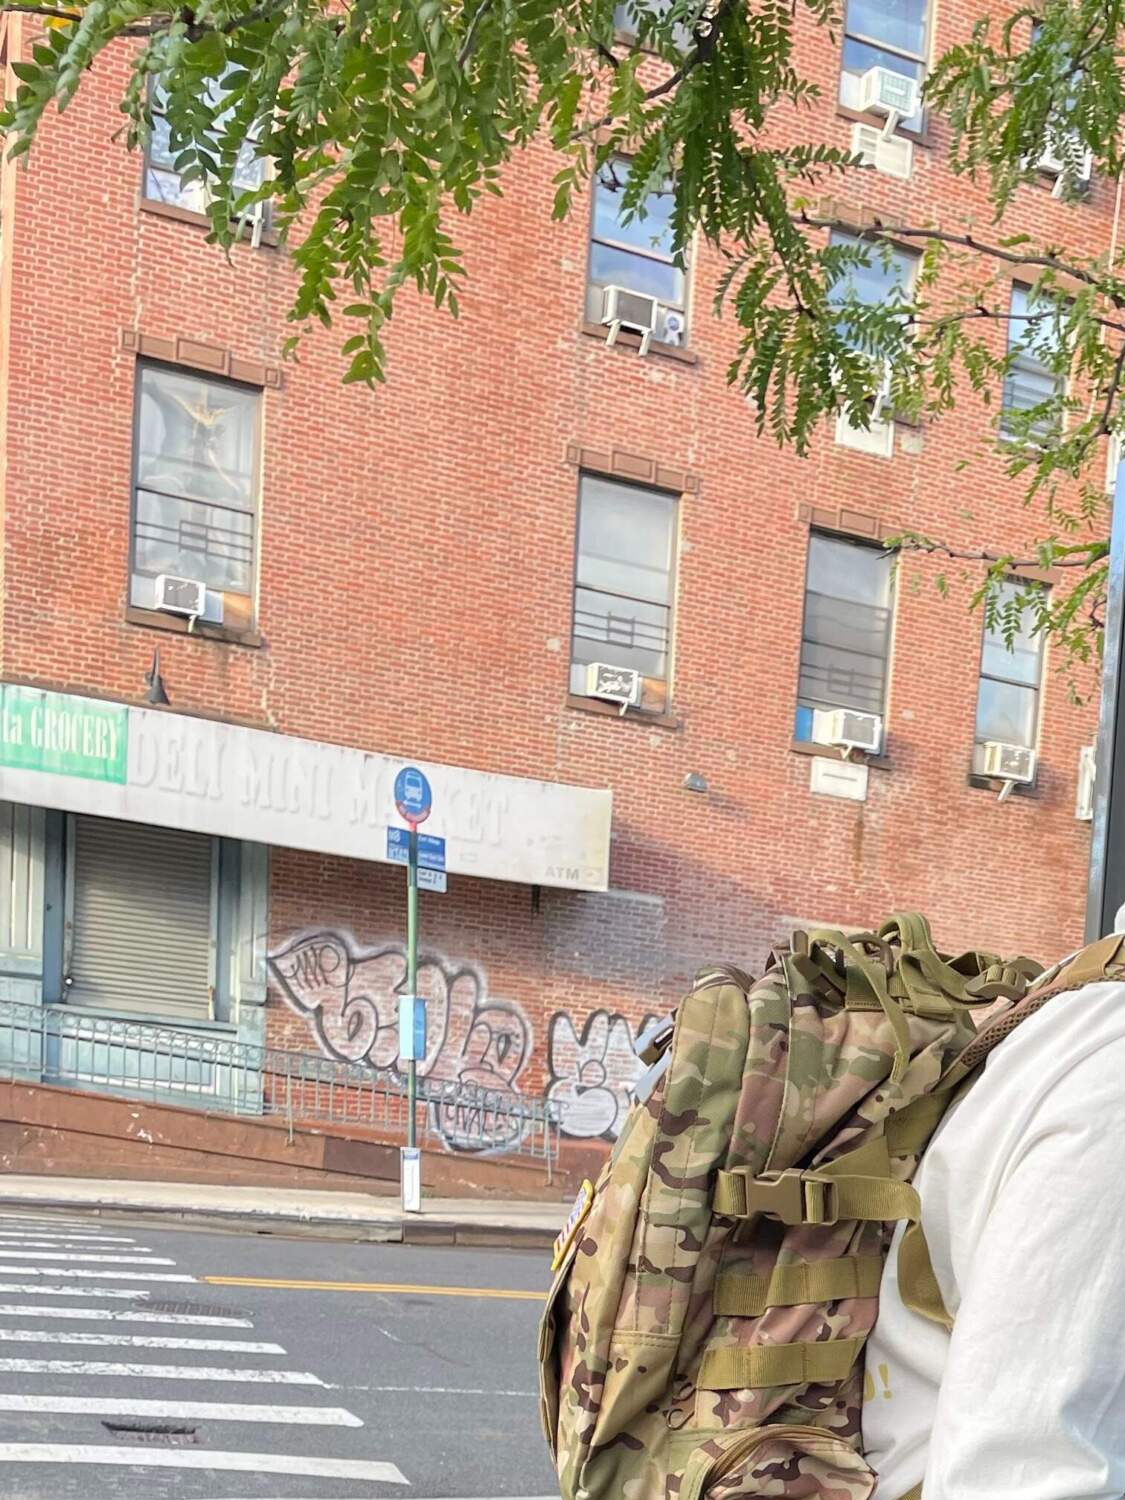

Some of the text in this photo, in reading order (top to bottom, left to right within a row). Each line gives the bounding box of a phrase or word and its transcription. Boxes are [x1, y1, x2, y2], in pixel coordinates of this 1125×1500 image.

[30, 706, 120, 761] GROCERY
[129, 727, 226, 800] DELI
[240, 745, 334, 820] MINI
[350, 764, 509, 847] MKET
[545, 865, 579, 880] ATM
